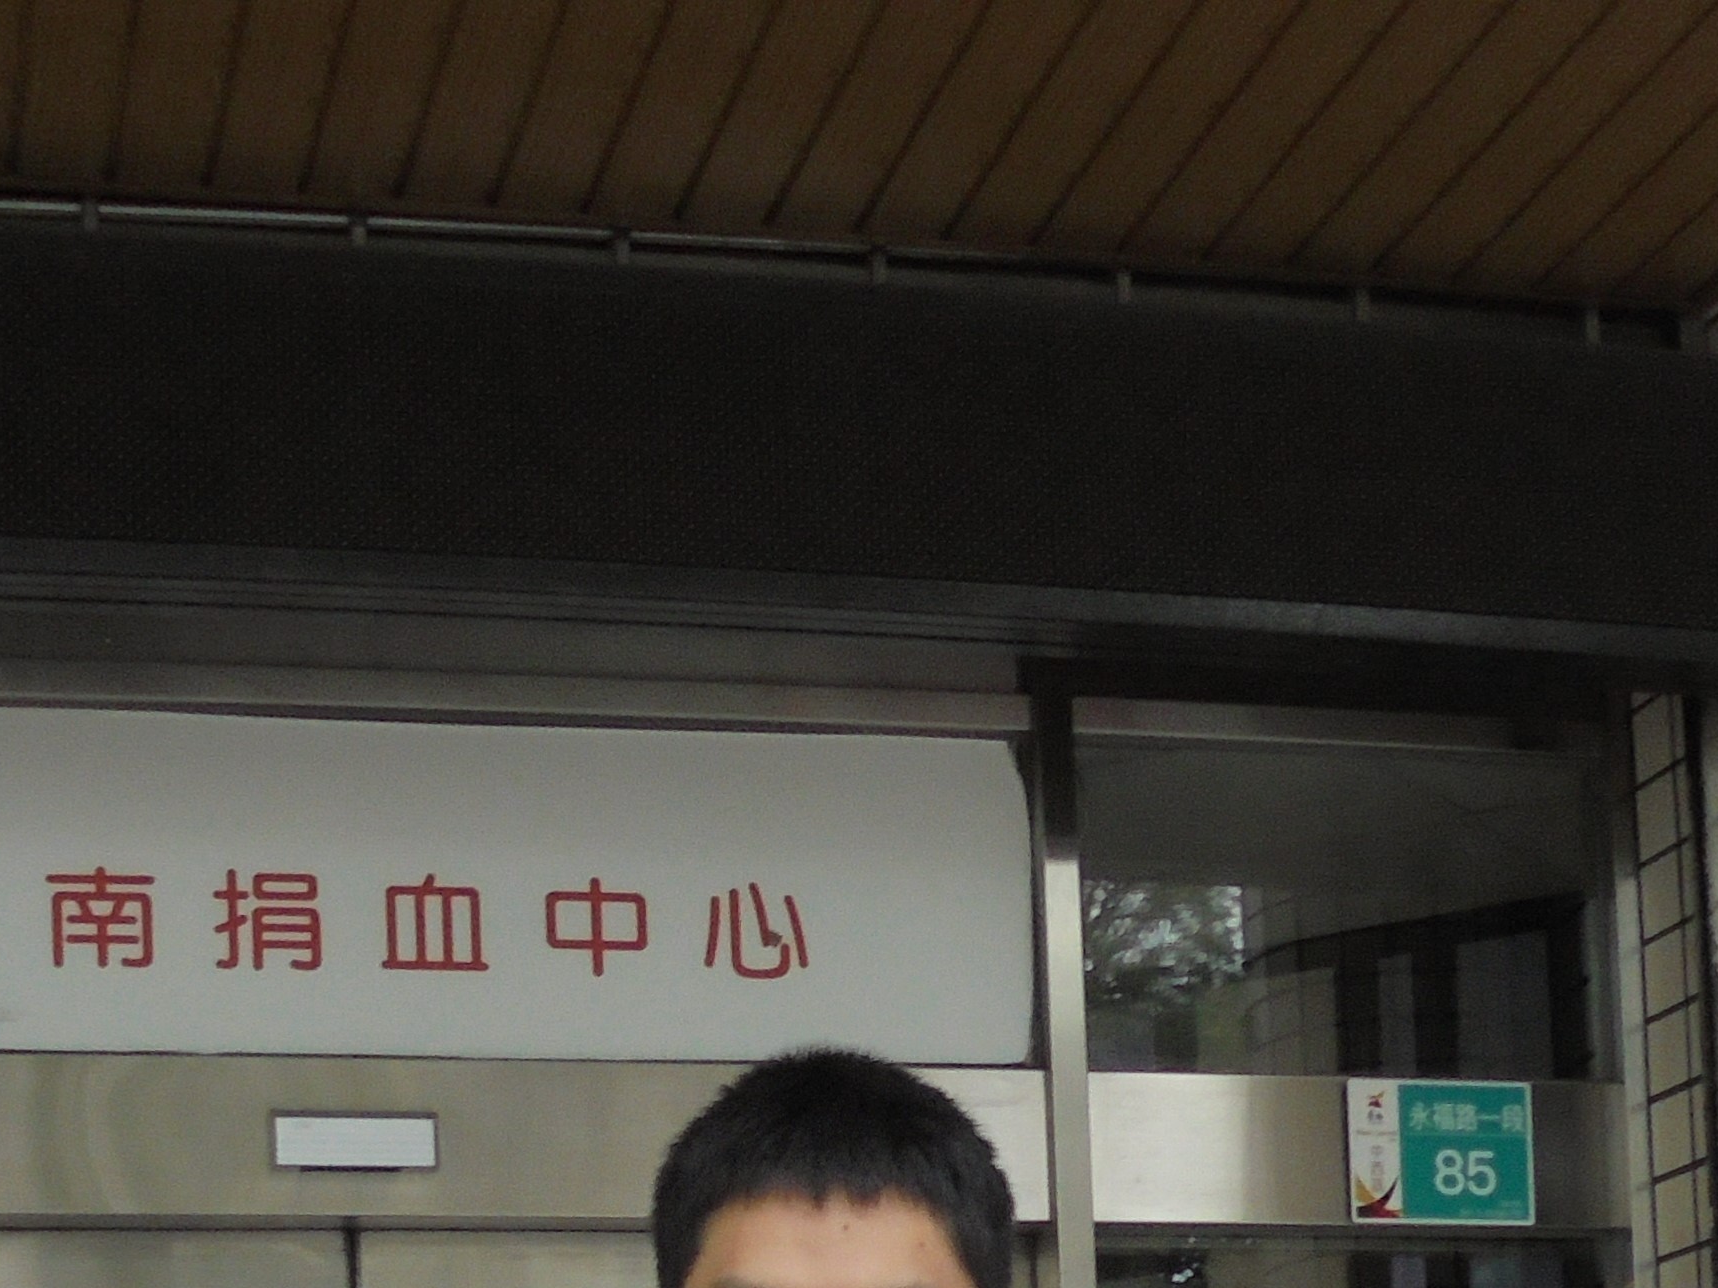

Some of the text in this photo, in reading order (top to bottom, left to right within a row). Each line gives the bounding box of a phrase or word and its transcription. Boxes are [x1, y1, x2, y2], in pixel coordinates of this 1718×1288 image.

[1408, 1101, 1524, 1132] 永福路一段
[1434, 1148, 1497, 1197] 85
